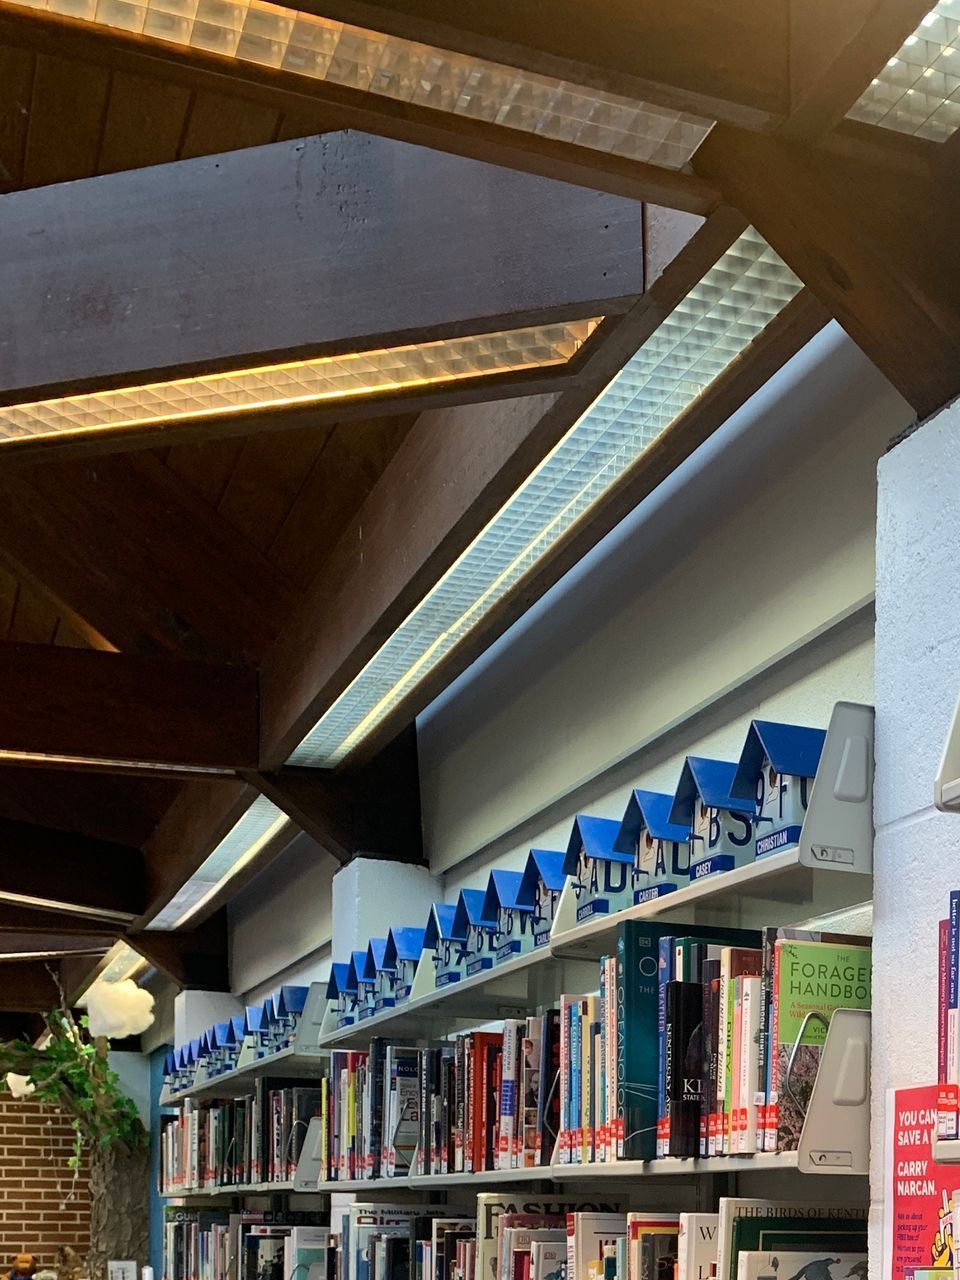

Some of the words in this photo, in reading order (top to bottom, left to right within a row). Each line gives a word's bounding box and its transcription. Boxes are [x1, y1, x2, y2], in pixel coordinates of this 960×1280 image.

[756, 830, 787, 855] CHRISTIAN
[695, 860, 712, 878] CASEY
[836, 954, 850, 963] THE
[790, 962, 872, 983] FORAGE
[790, 981, 872, 1000] HANDBO
[899, 1110, 917, 1127] YOU
[919, 1108, 938, 1126] CAN
[898, 1130, 921, 1146] SAVE
[898, 1161, 928, 1177] CARRY
[898, 1180, 937, 1197] NARCAN.
[736, 1206, 766, 1218] THE
[769, 1206, 805, 1218] BIRDS
